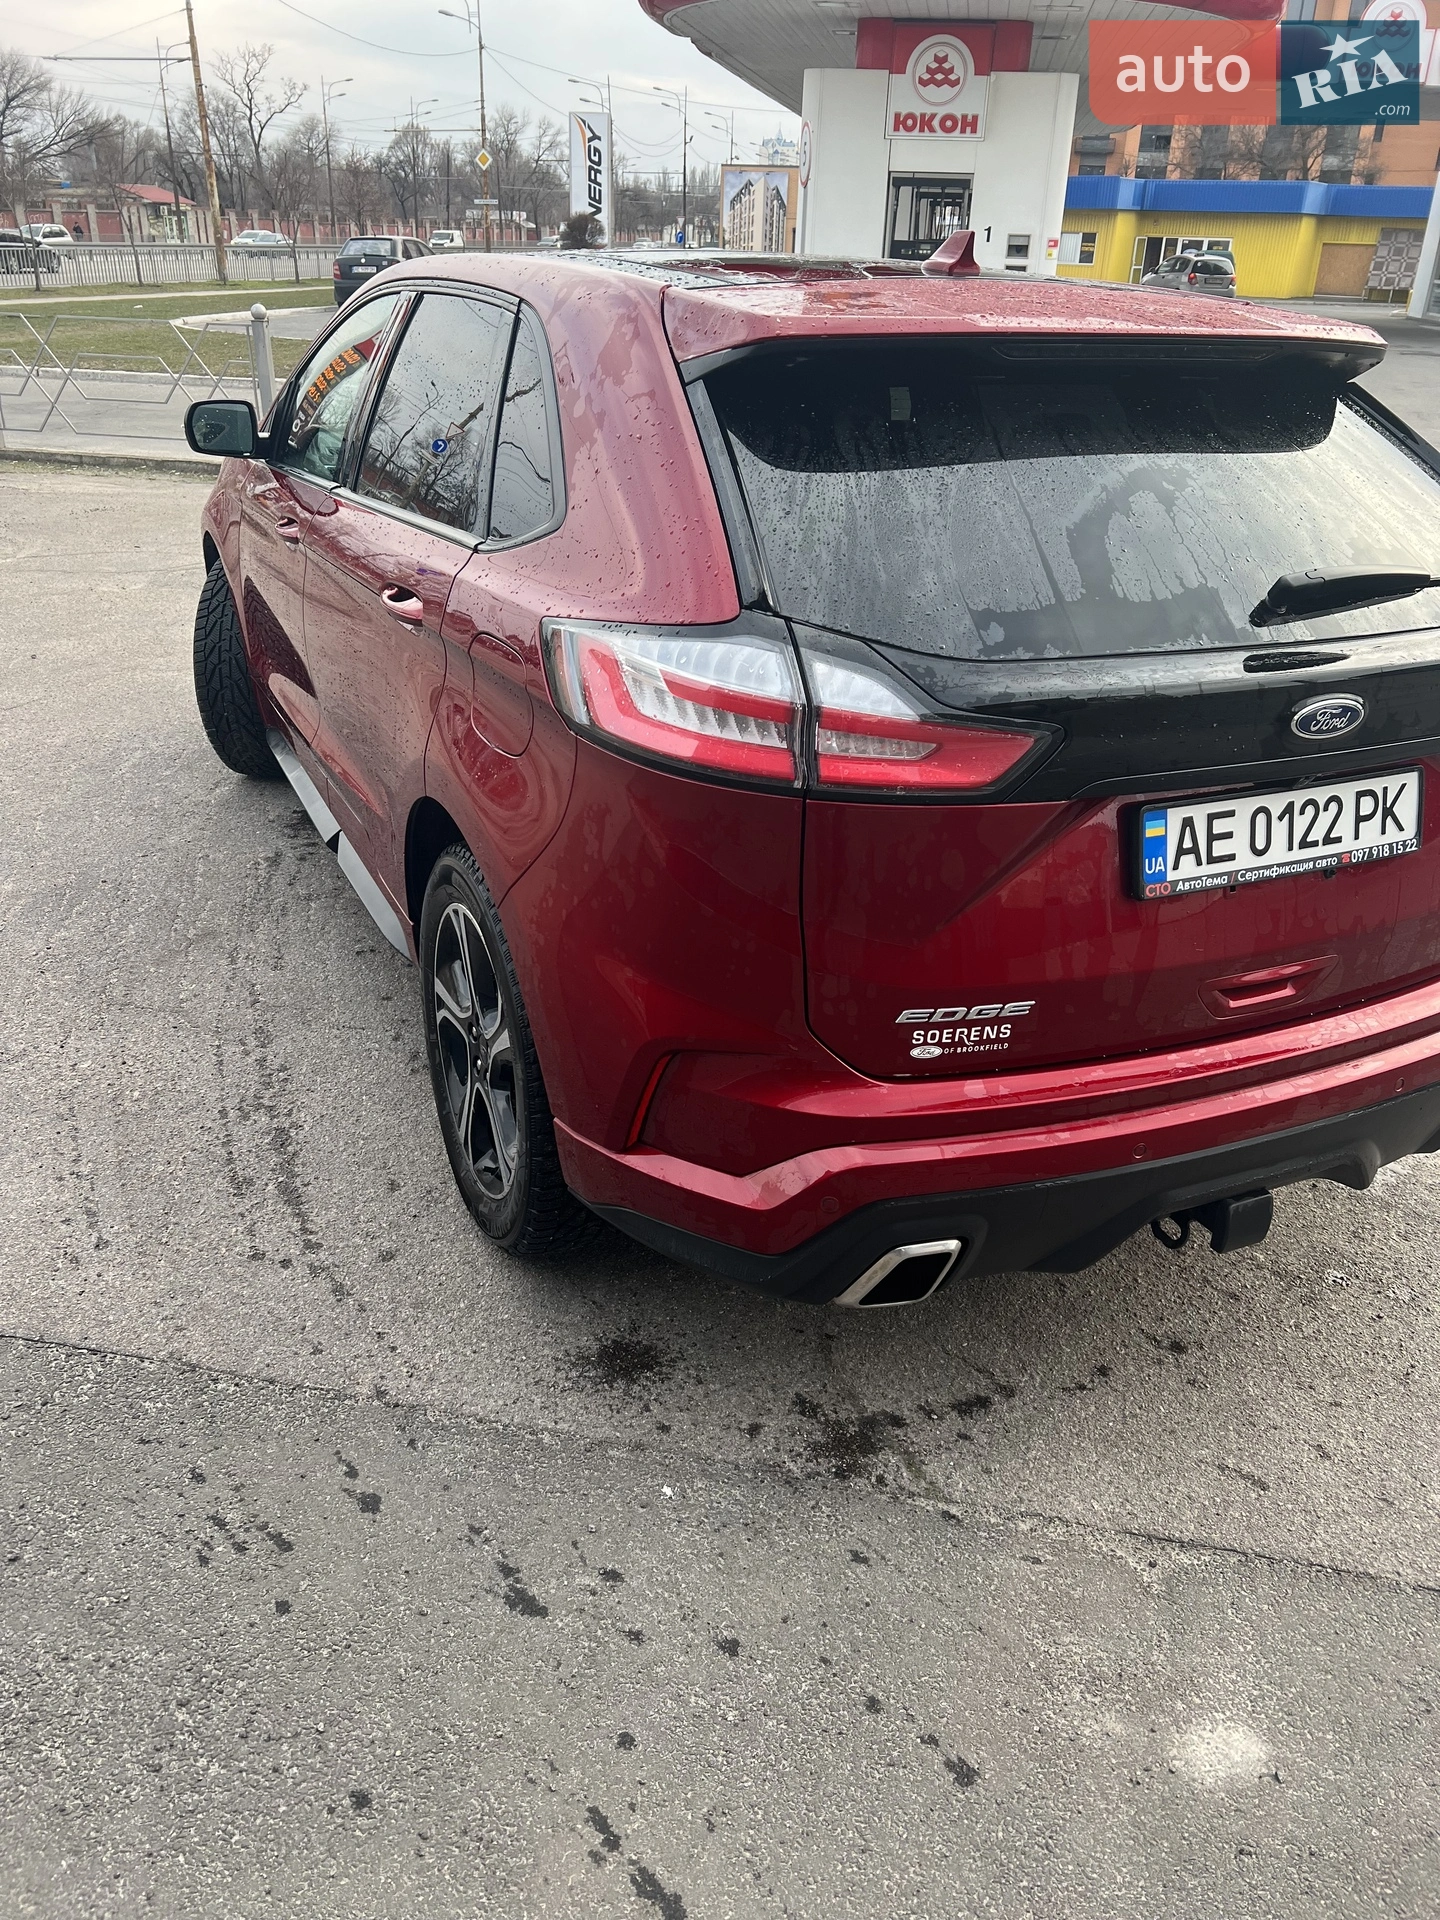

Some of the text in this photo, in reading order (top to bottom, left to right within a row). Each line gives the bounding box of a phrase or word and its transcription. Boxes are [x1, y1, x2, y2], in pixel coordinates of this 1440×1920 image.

[893, 111, 979, 135] ЮКОН
[587, 121, 602, 218] NERGY
[983, 226, 992, 243] 1
[1310, 706, 1350, 731] Ford
[1172, 782, 1407, 871] AE 0122 PK
[1145, 857, 1165, 874] UA
[1146, 882, 1171, 897] СТО
[1176, 874, 1228, 892] АвтоТема
[1237, 860, 1314, 882] Сертификация
[1315, 857, 1338, 868] авто
[1351, 849, 1370, 863] 097
[1372, 844, 1390, 859] 918
[1392, 842, 1403, 854] 15
[1405, 838, 1418, 852] 22
[895, 1000, 1036, 1024] EDGE
[911, 1023, 1012, 1046] SOERENS
[956, 1043, 1009, 1053] BROOKFIELD
